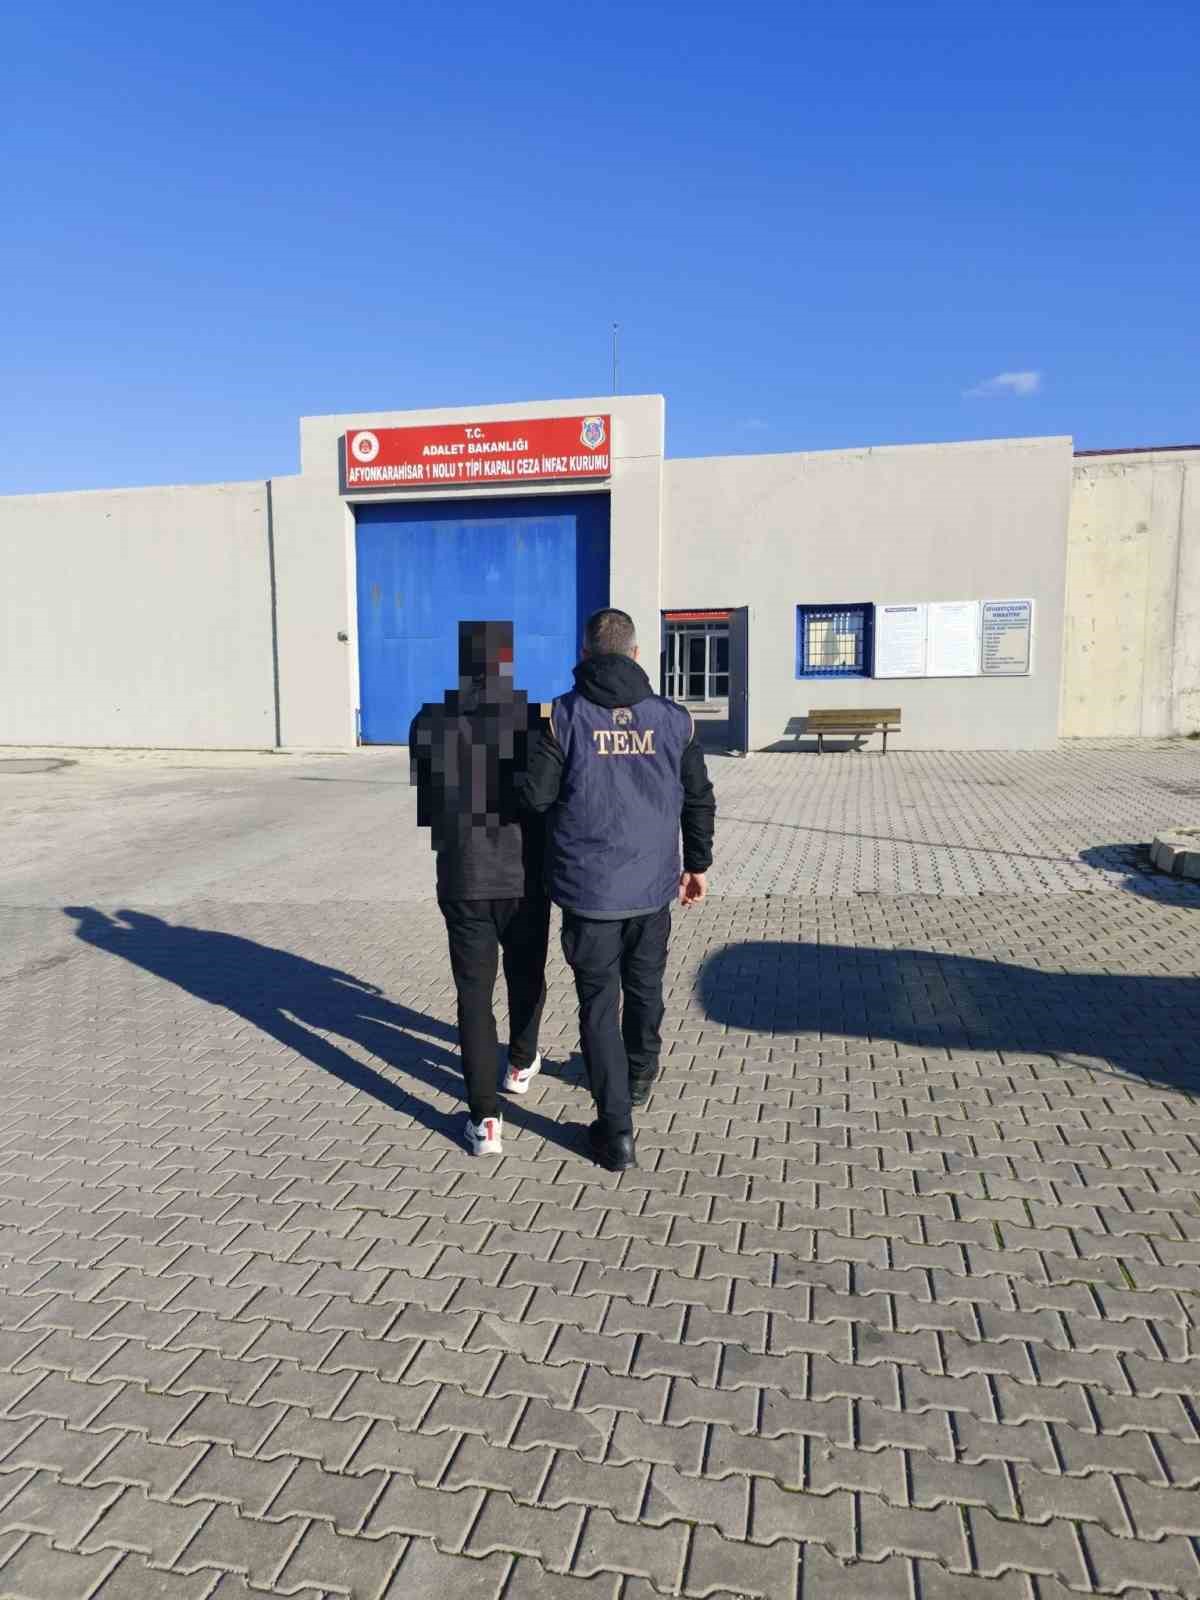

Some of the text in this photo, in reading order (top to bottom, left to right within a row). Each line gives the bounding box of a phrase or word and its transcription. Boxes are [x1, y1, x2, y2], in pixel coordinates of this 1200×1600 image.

[465, 428, 485, 438] T.C.
[423, 440, 528, 456] ADALET BAKANLIĞI
[349, 454, 608, 481] AFYONKARAHİSAR 1 NOLU T TİPİ KAPALI CEZA İNFAZ KURUMU
[593, 729, 656, 756] TEM
